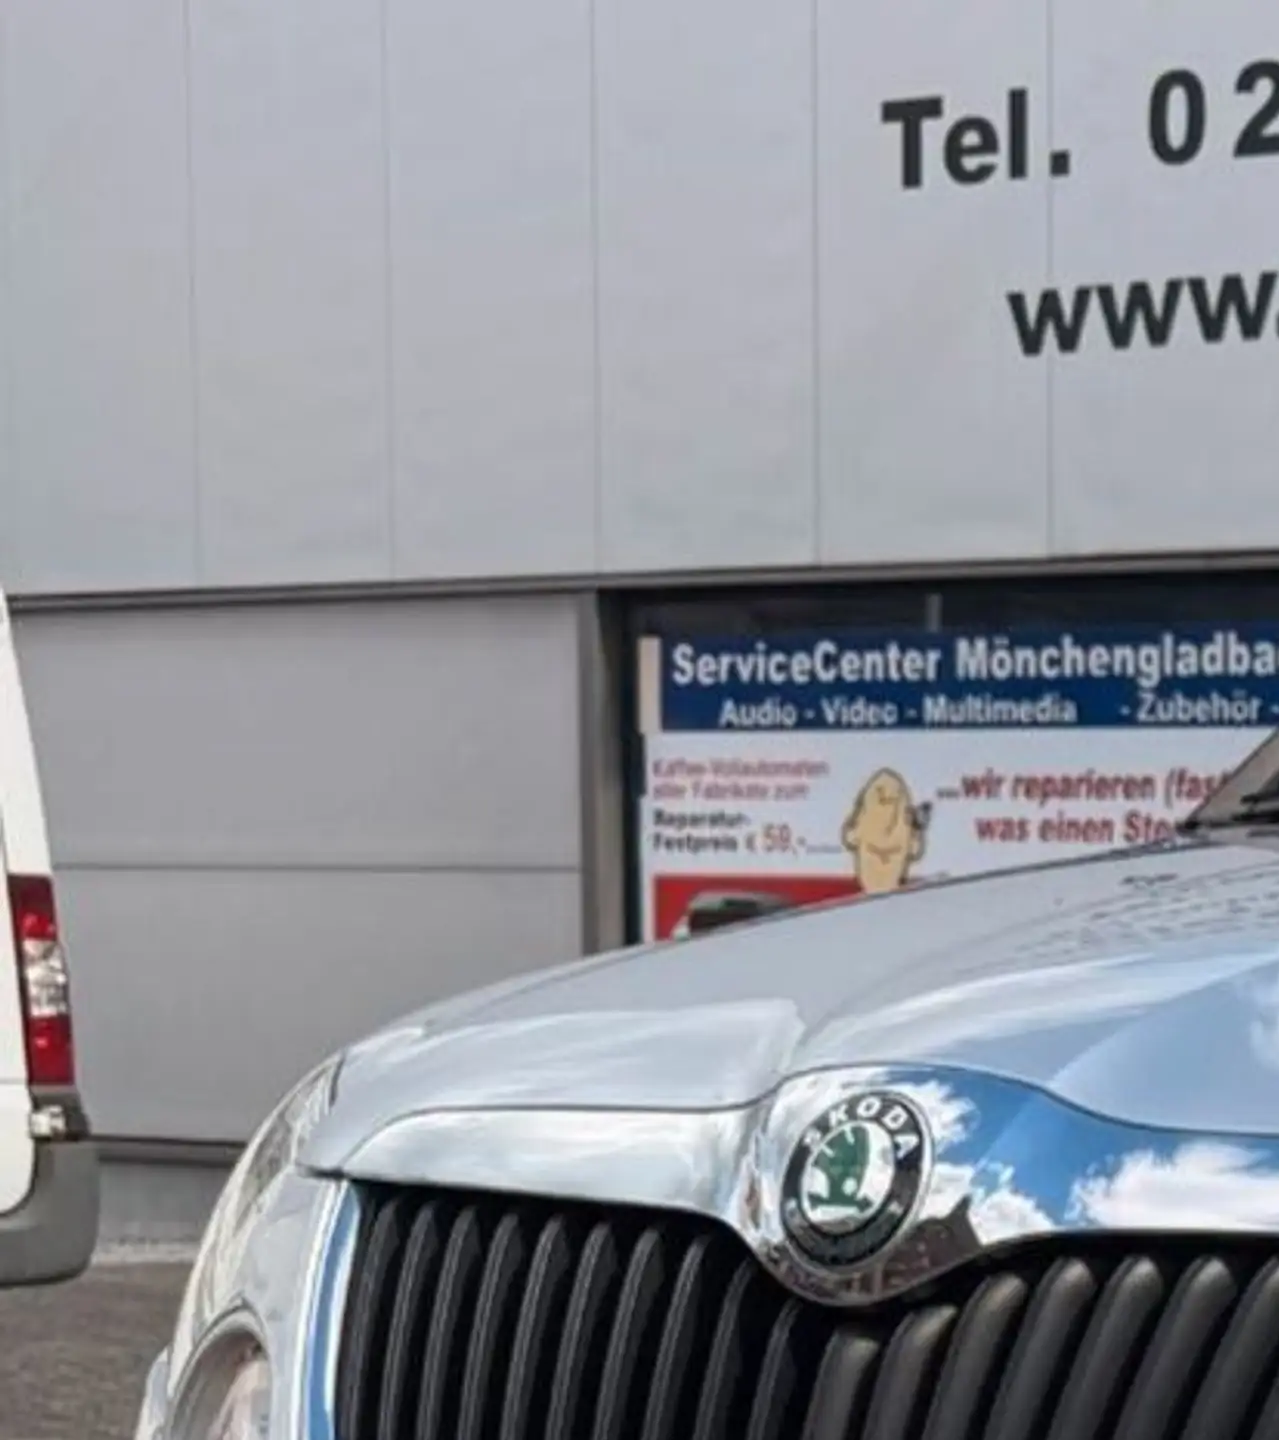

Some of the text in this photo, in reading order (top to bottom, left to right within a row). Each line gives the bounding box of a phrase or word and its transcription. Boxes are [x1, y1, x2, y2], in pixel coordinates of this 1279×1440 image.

[882, 88, 1070, 189] Tel.
[671, 639, 942, 686] ServiceCenter
[718, 698, 798, 727] Audio
[820, 697, 899, 725] Video
[922, 692, 1078, 725] Multimedia
[1136, 688, 1262, 723] Zubehör
[1012, 767, 1156, 809] reparieren
[975, 815, 1031, 843] was
[1039, 810, 1115, 843] einen
